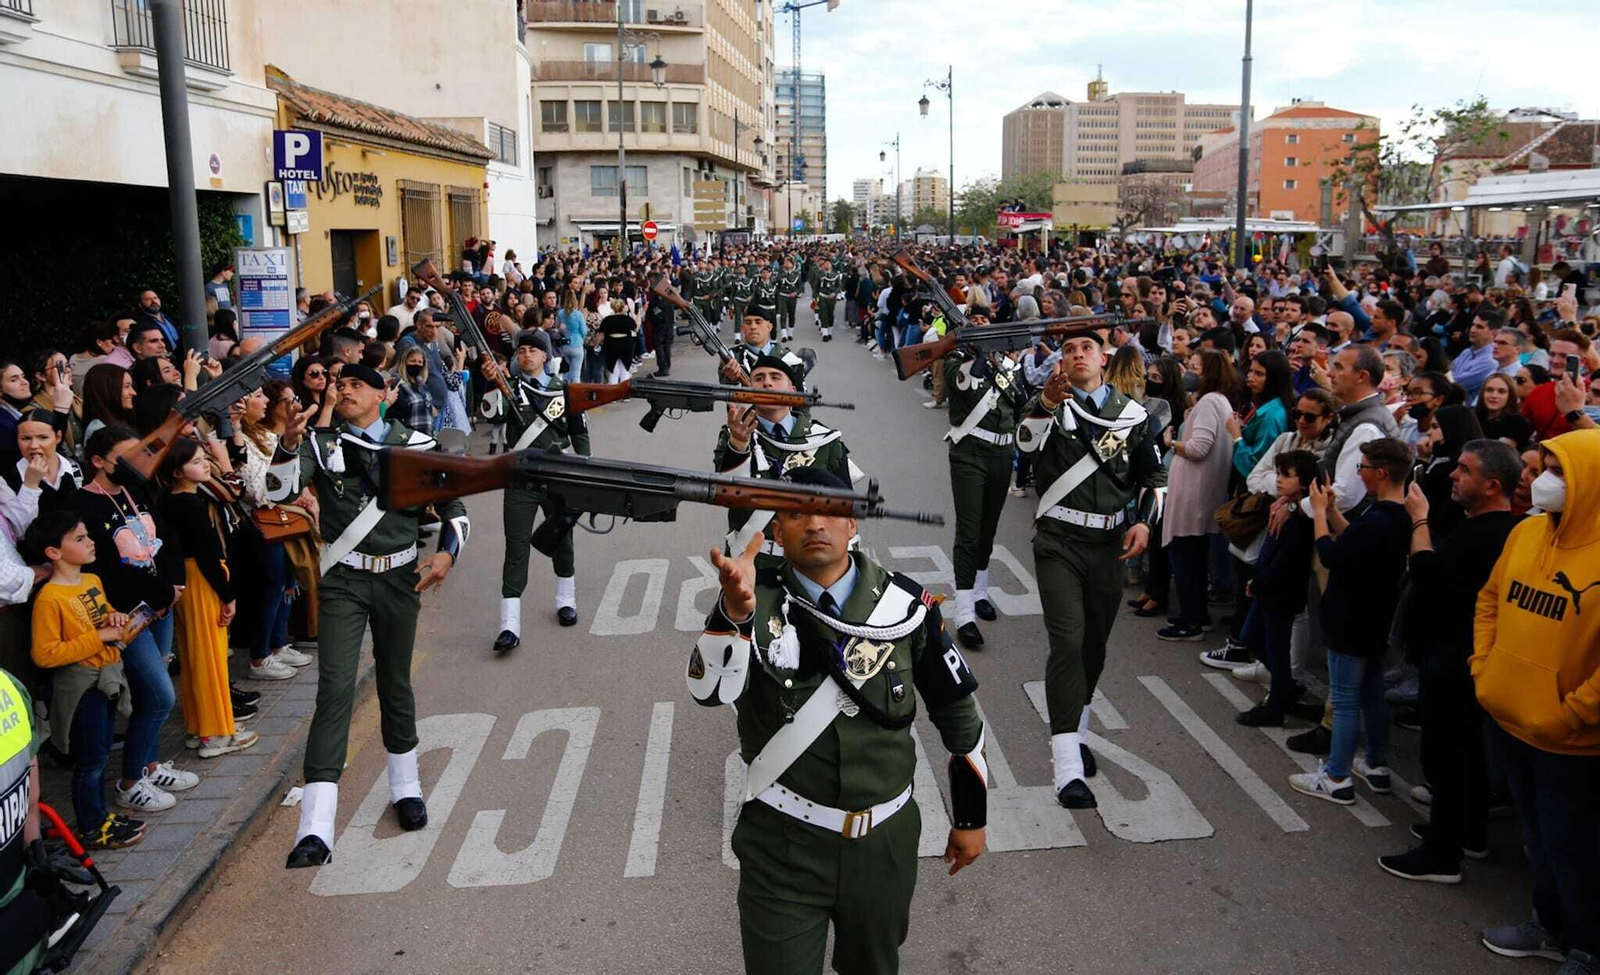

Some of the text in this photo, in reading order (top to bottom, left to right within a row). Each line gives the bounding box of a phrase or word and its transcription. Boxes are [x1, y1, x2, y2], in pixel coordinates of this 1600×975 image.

[284, 132, 311, 169] P
[278, 168, 318, 181] HOTEL
[287, 180, 304, 195] TAXI
[239, 253, 286, 267] TAXI
[1506, 580, 1568, 621] PUMA
[943, 643, 970, 685] P
